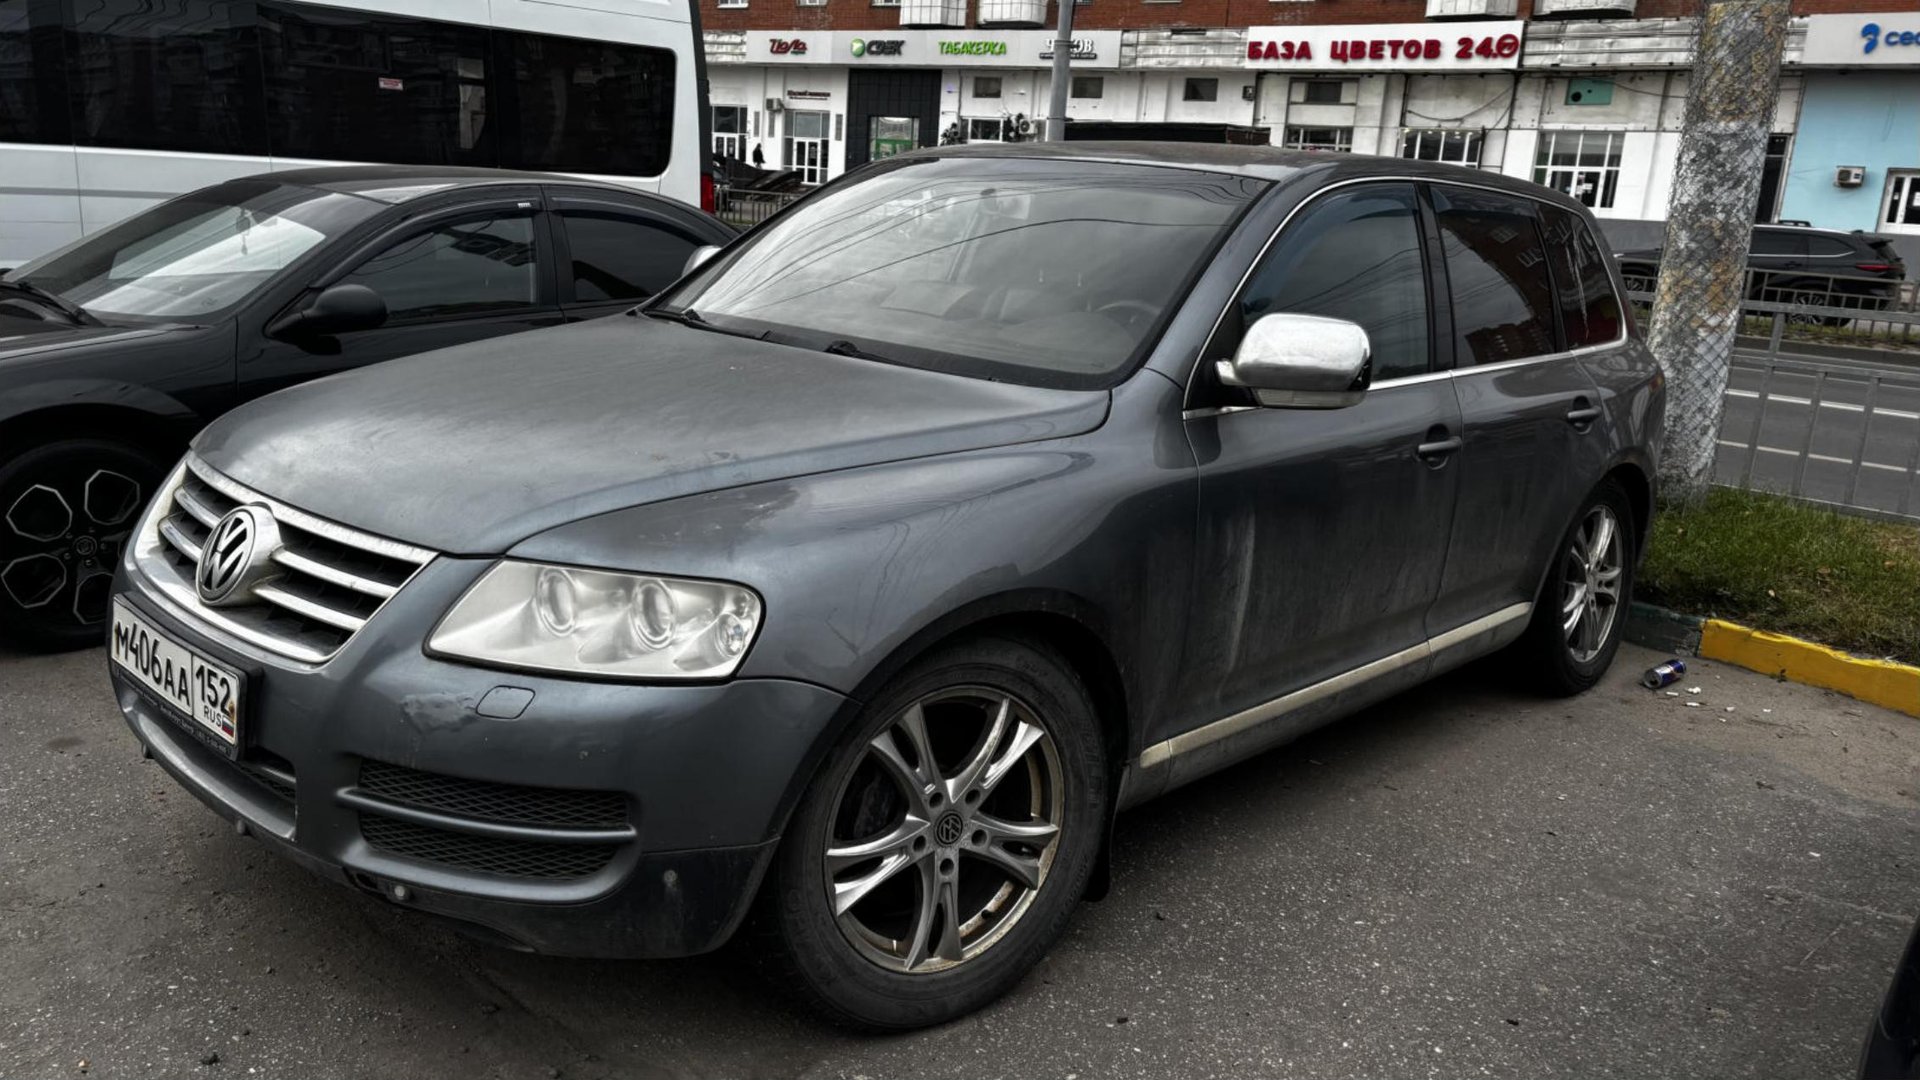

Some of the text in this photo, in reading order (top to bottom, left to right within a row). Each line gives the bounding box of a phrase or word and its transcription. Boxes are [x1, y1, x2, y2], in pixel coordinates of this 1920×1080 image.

[938, 41, 1006, 56] ТАБАКЕРКА
[1248, 41, 1312, 60] БАЗА
[1330, 39, 1441, 62] ЦВЕТОВ
[196, 664, 232, 716] 152
[203, 705, 222, 728] RUS
